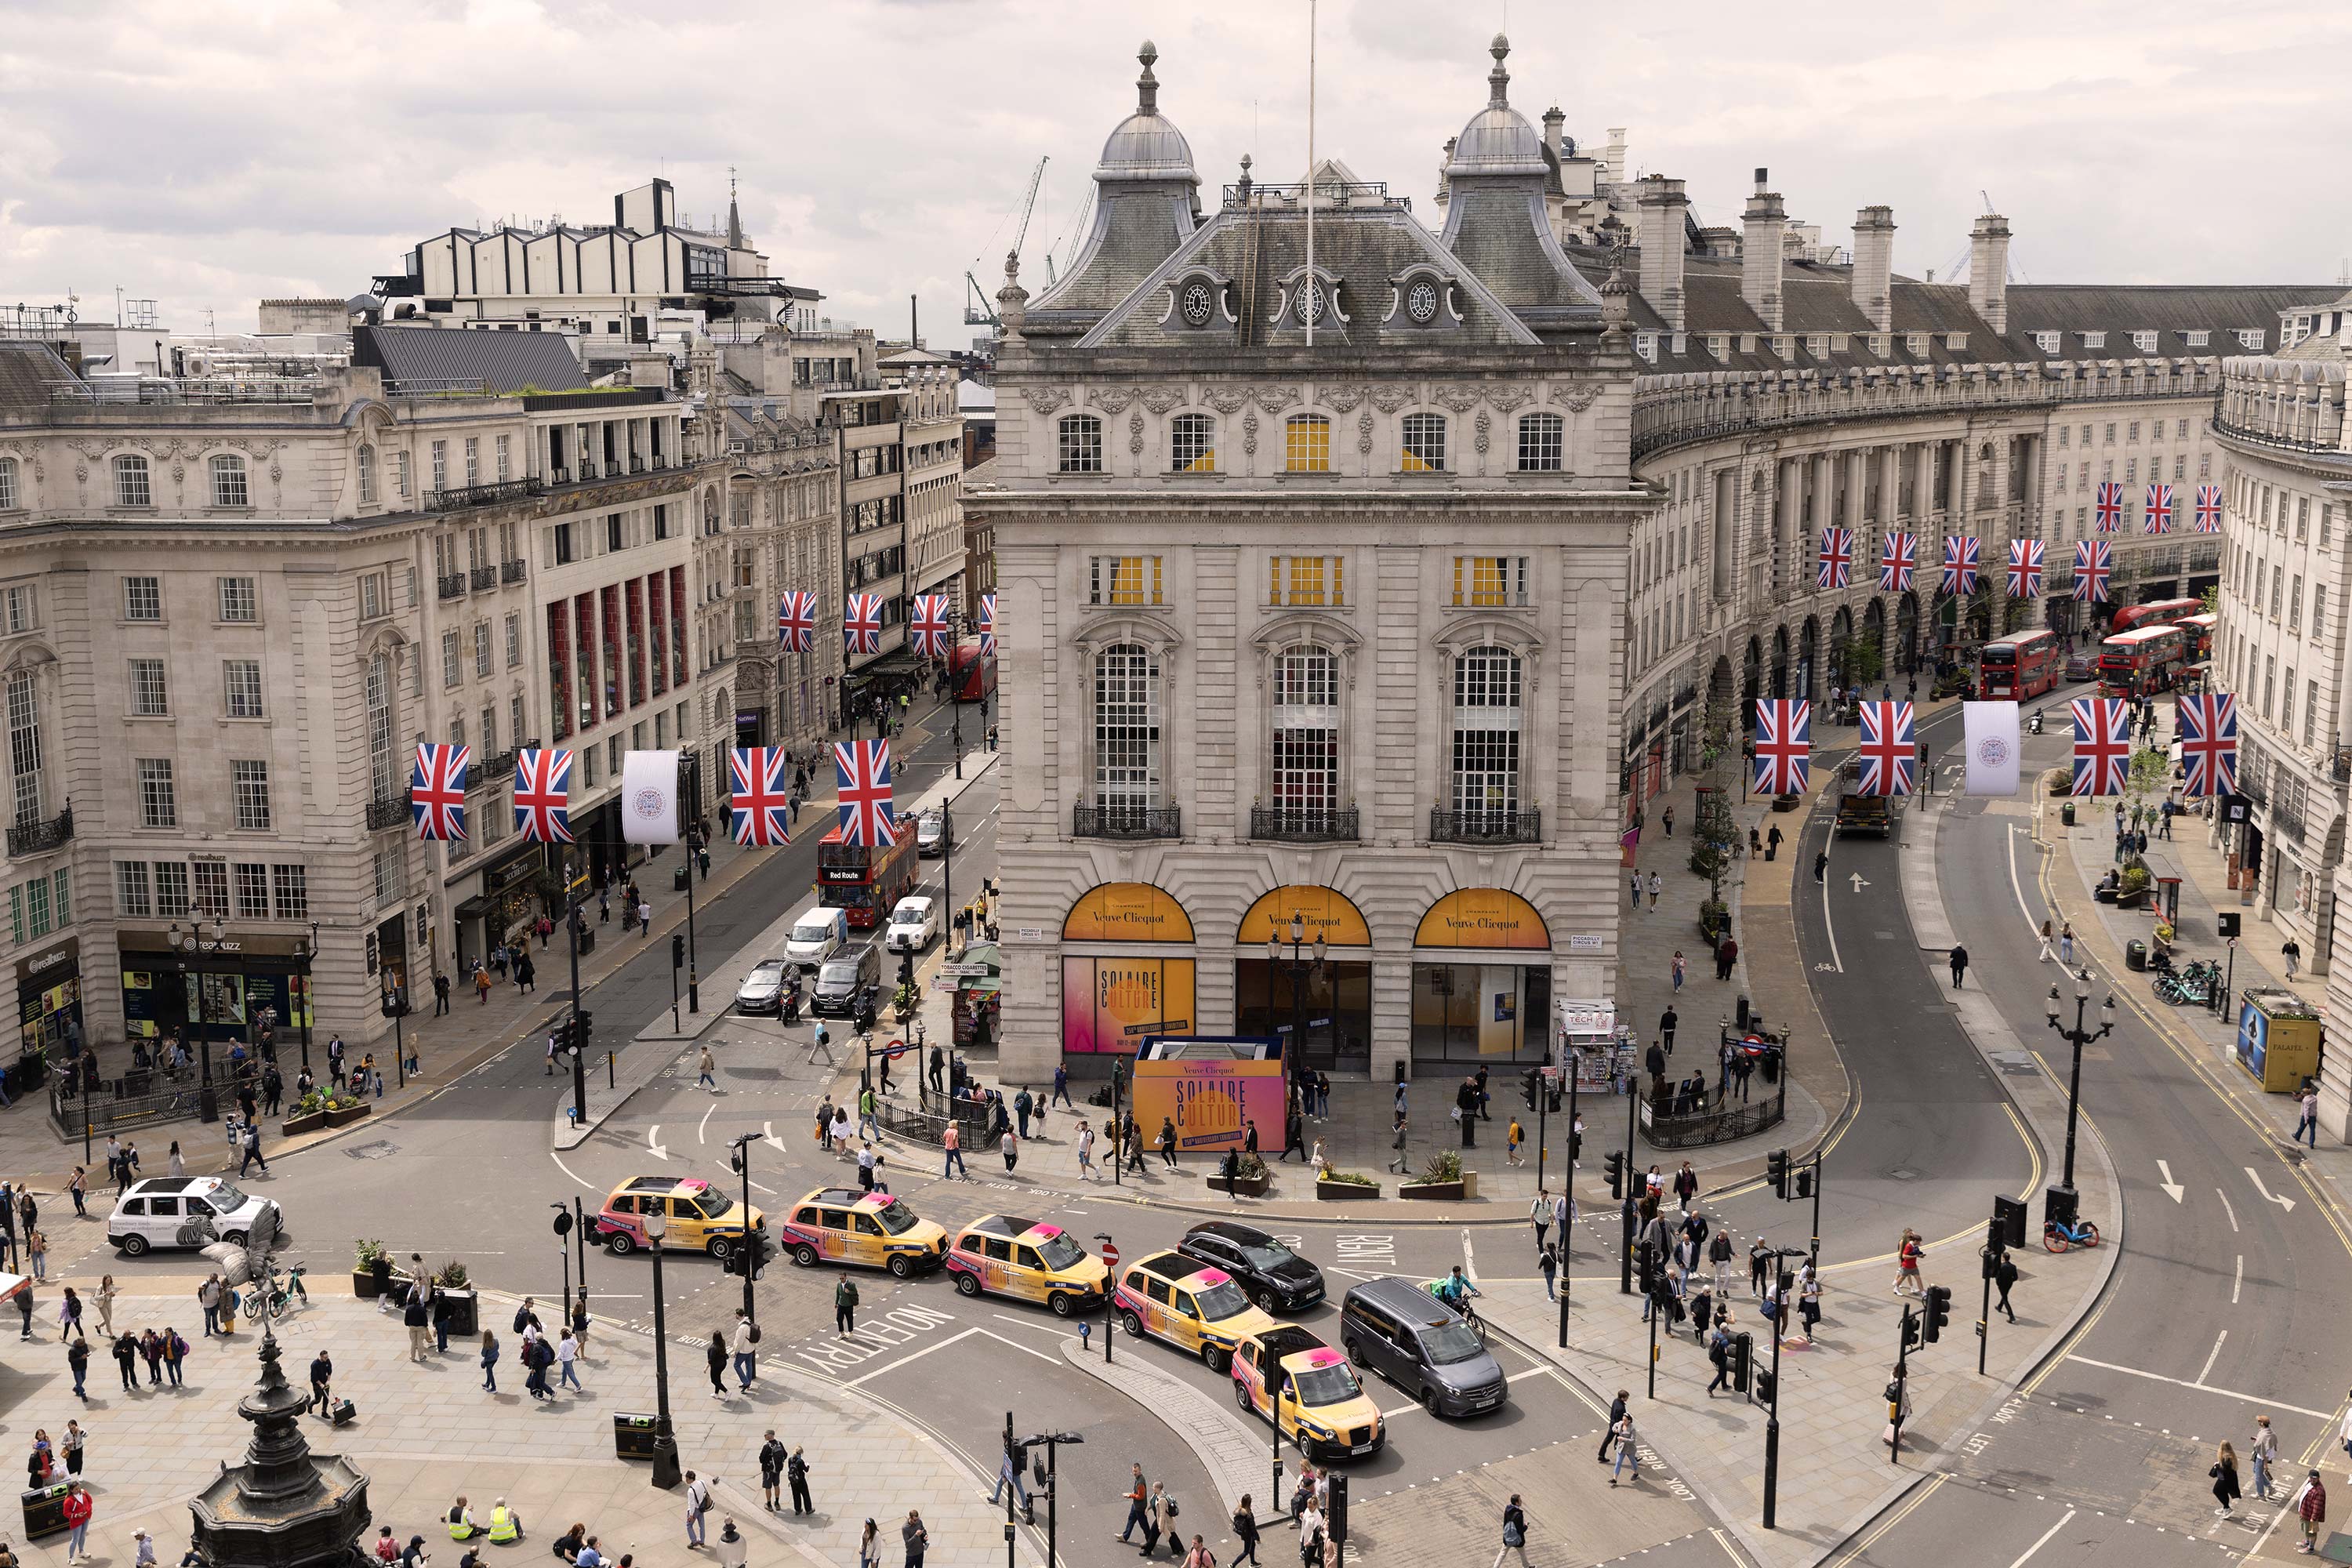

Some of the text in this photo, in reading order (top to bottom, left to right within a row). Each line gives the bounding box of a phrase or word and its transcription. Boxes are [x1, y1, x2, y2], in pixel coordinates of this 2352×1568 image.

[198, 853, 227, 862] realbuzz
[1094, 912, 1164, 925] Veuve Clicquot
[1446, 917, 1519, 931] Veuve Clicquot
[38, 950, 67, 969] realbuzz
[1101, 971, 1156, 990] SOLAIRE
[1101, 989, 1156, 1009] CULTURE
[1136, 1023, 1162, 1033] ANNIVERSARY
[1164, 1021, 1186, 1030] EXHIBITION
[1739, 1041, 1768, 1050] UNDERGROUND
[1205, 1066, 1235, 1075] Clicquot
[1176, 1080, 1246, 1104] SOLAIRE
[1177, 1103, 1247, 1127] CULTURE
[1194, 1134, 1219, 1145] ANNIVERSARY
[1219, 1132, 1241, 1142] EXHIBITION
[950, 1177, 1058, 1197] LOOK BOTH WAYS
[1336, 1235, 1396, 1266] RGNT
[885, 1303, 956, 1330] NO
[676, 1334, 710, 1348] BOTH
[796, 1319, 917, 1375] ENTRY
[1988, 1403, 2021, 1425] LOOK
[1962, 1432, 1993, 1456] LEFT
[1664, 1477, 1697, 1501] LOOK
[2236, 1510, 2270, 1534] LOOK
